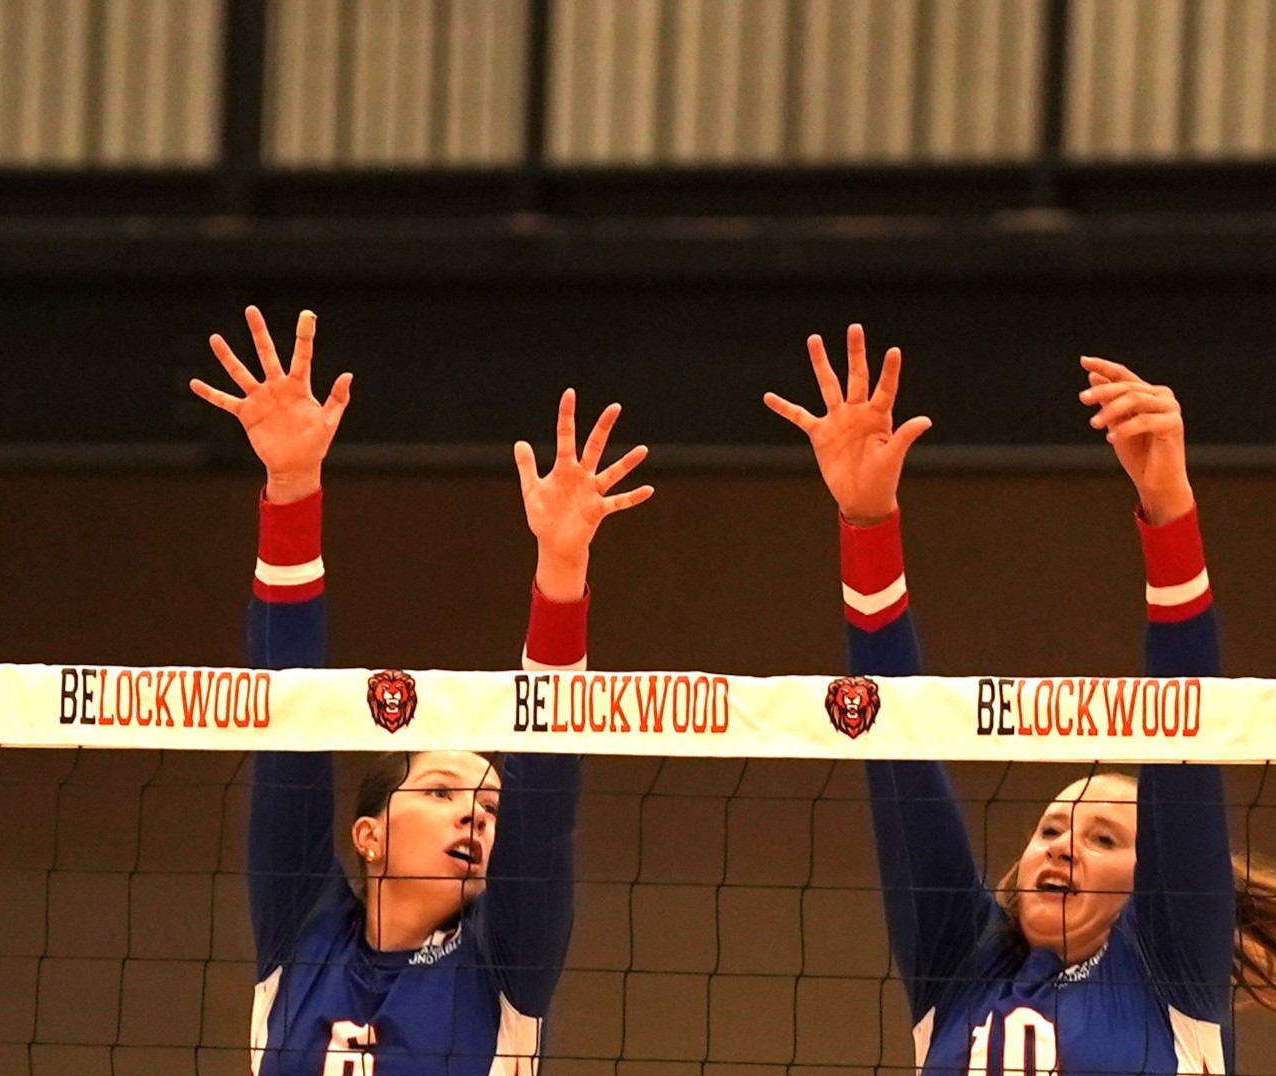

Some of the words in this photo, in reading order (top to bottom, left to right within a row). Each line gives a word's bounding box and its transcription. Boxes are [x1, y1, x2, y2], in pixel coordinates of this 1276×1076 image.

[60, 668, 270, 728] BELOCKWOOD
[514, 675, 728, 733] BELOCKWOOD
[977, 678, 1200, 737] BELOCKWOOD
